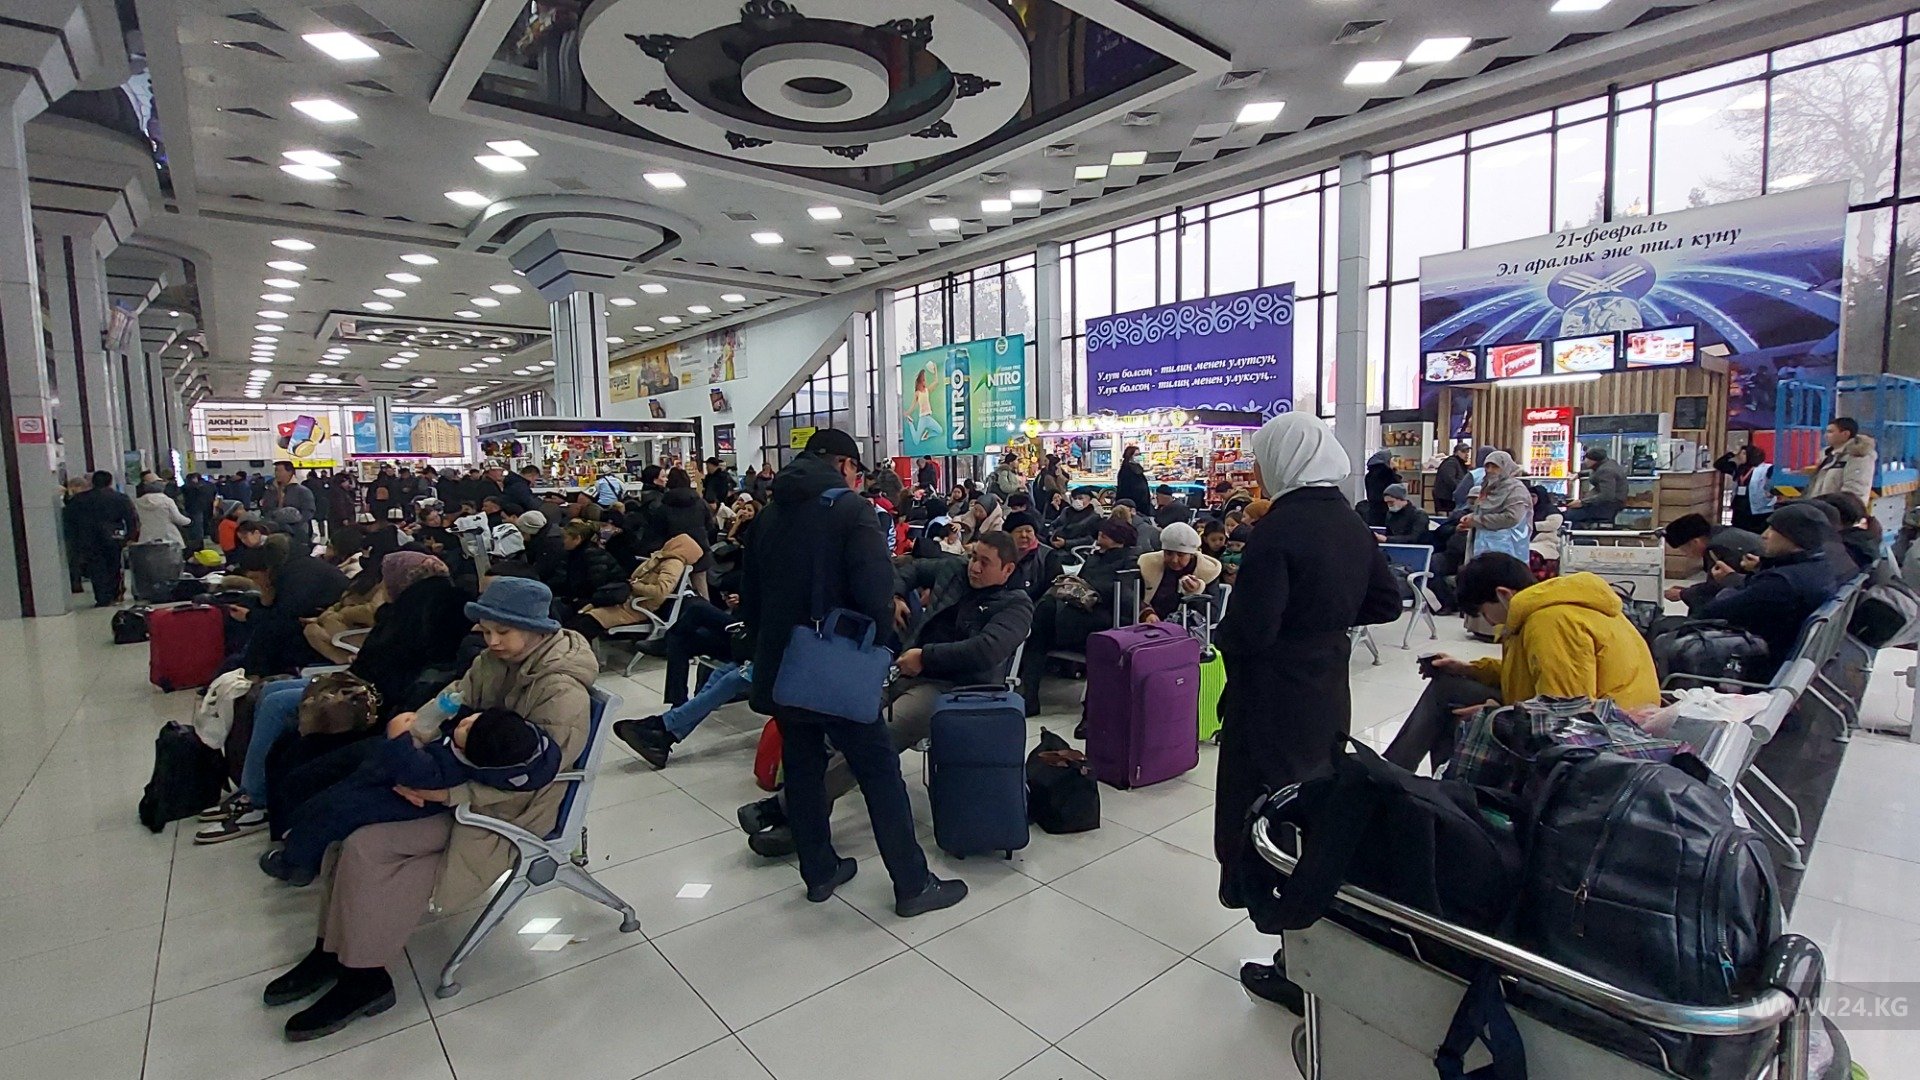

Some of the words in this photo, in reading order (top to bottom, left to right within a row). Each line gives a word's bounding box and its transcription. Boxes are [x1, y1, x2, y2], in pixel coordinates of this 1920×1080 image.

[1555, 220, 1668, 249] 21-февраль
[1496, 262, 1519, 277] Эл
[1524, 251, 1596, 276] аралык
[1601, 246, 1633, 261] эне
[1639, 238, 1684, 255] тил
[987, 370, 1021, 387] NITRO
[1097, 371, 1120, 383] Улут
[1193, 359, 1226, 371] менен
[1097, 385, 1119, 397] Улук
[1191, 375, 1223, 387] менен
[951, 369, 965, 441] NITRO
[207, 418, 248, 426] АКЫСЫЗ
